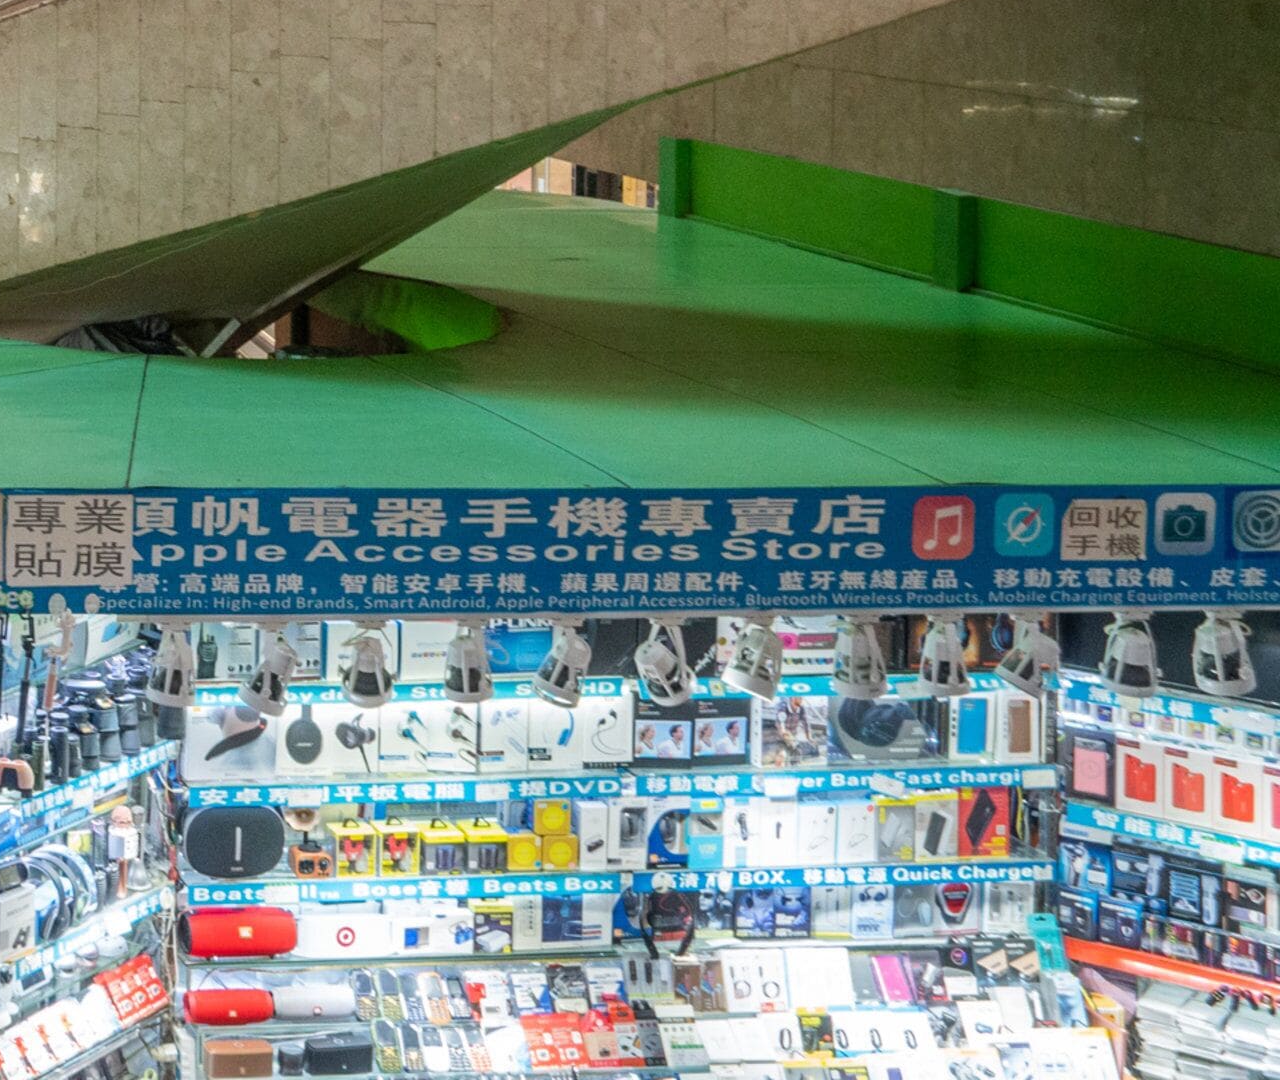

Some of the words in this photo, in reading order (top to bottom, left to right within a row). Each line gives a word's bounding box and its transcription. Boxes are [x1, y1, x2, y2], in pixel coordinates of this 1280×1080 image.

[12, 498, 127, 534] 專業
[1068, 505, 1142, 530] 回收
[305, 538, 701, 564] Accessories
[721, 538, 886, 561] Store
[1067, 533, 1143, 559] 手機
[11, 542, 127, 578] 貼膜
[212, 596, 292, 613] High-end
[296, 596, 359, 613] Brands,
[363, 595, 413, 610] Smart
[418, 594, 491, 612] Android,
[495, 594, 544, 611] Apple
[548, 593, 634, 611] Peripheral
[745, 591, 828, 607] Bluetooth
[832, 590, 903, 606] Wireless
[988, 589, 1047, 604] Mobile
[1050, 589, 1124, 607] Charging
[290, 689, 313, 704] by
[581, 681, 616, 695] HD
[509, 779, 621, 799] 提DVD
[831, 772, 872, 788] Ban
[948, 768, 1021, 788] chargi
[483, 877, 558, 894] Beats
[563, 875, 615, 892] Box
[892, 865, 954, 882] Quick
